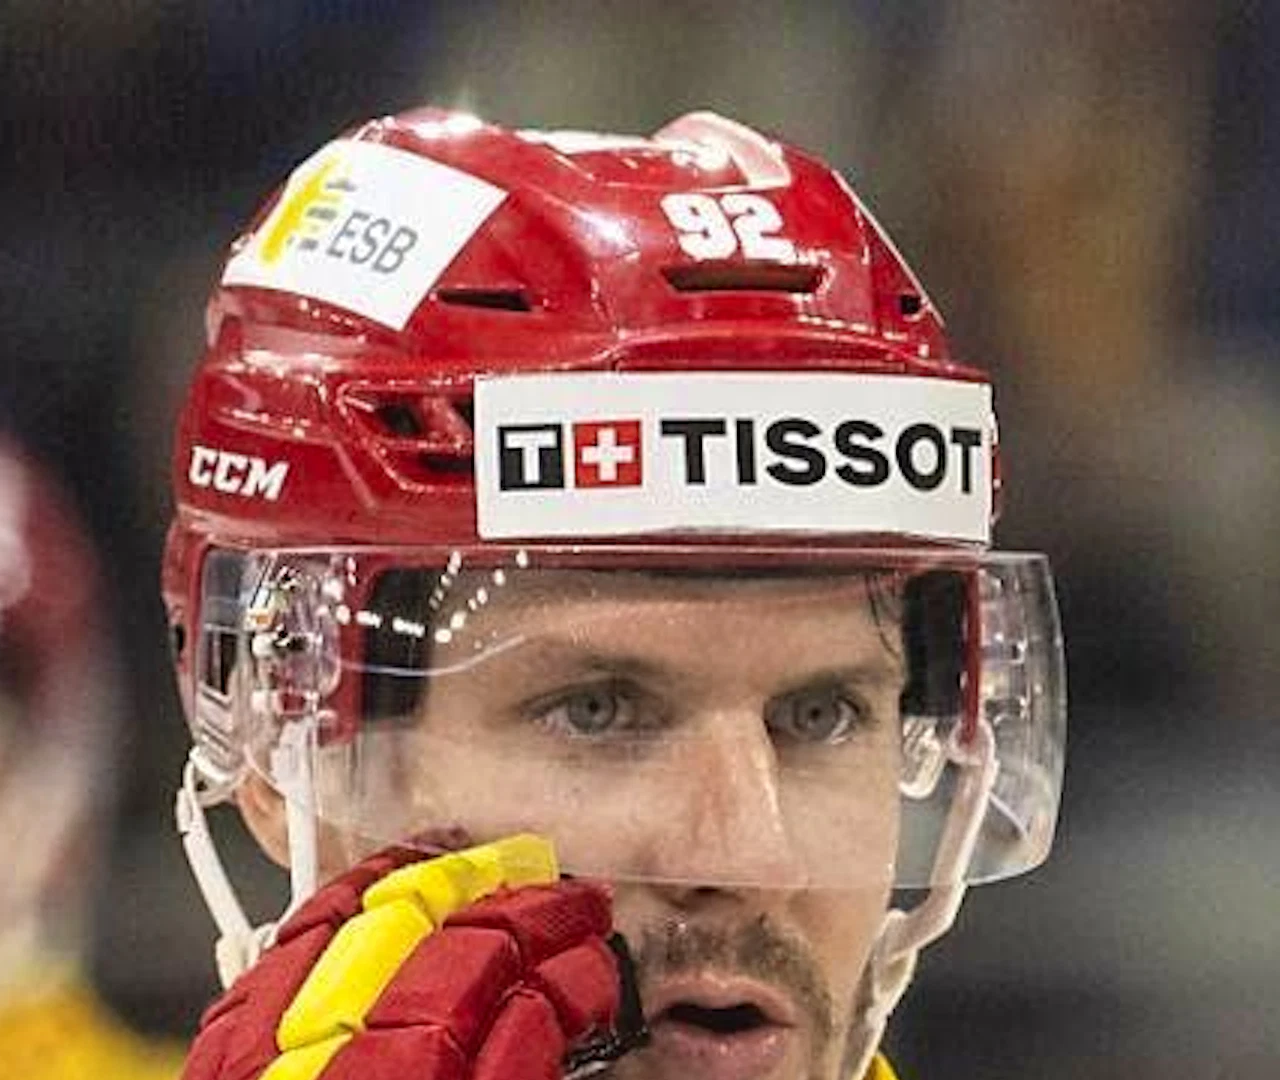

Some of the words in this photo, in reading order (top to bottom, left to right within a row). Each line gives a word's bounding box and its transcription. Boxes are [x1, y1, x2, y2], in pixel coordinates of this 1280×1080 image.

[326, 210, 418, 274] ESB
[660, 194, 794, 263] 92
[189, 445, 290, 500] CCM
[661, 418, 981, 494] TISSOT
